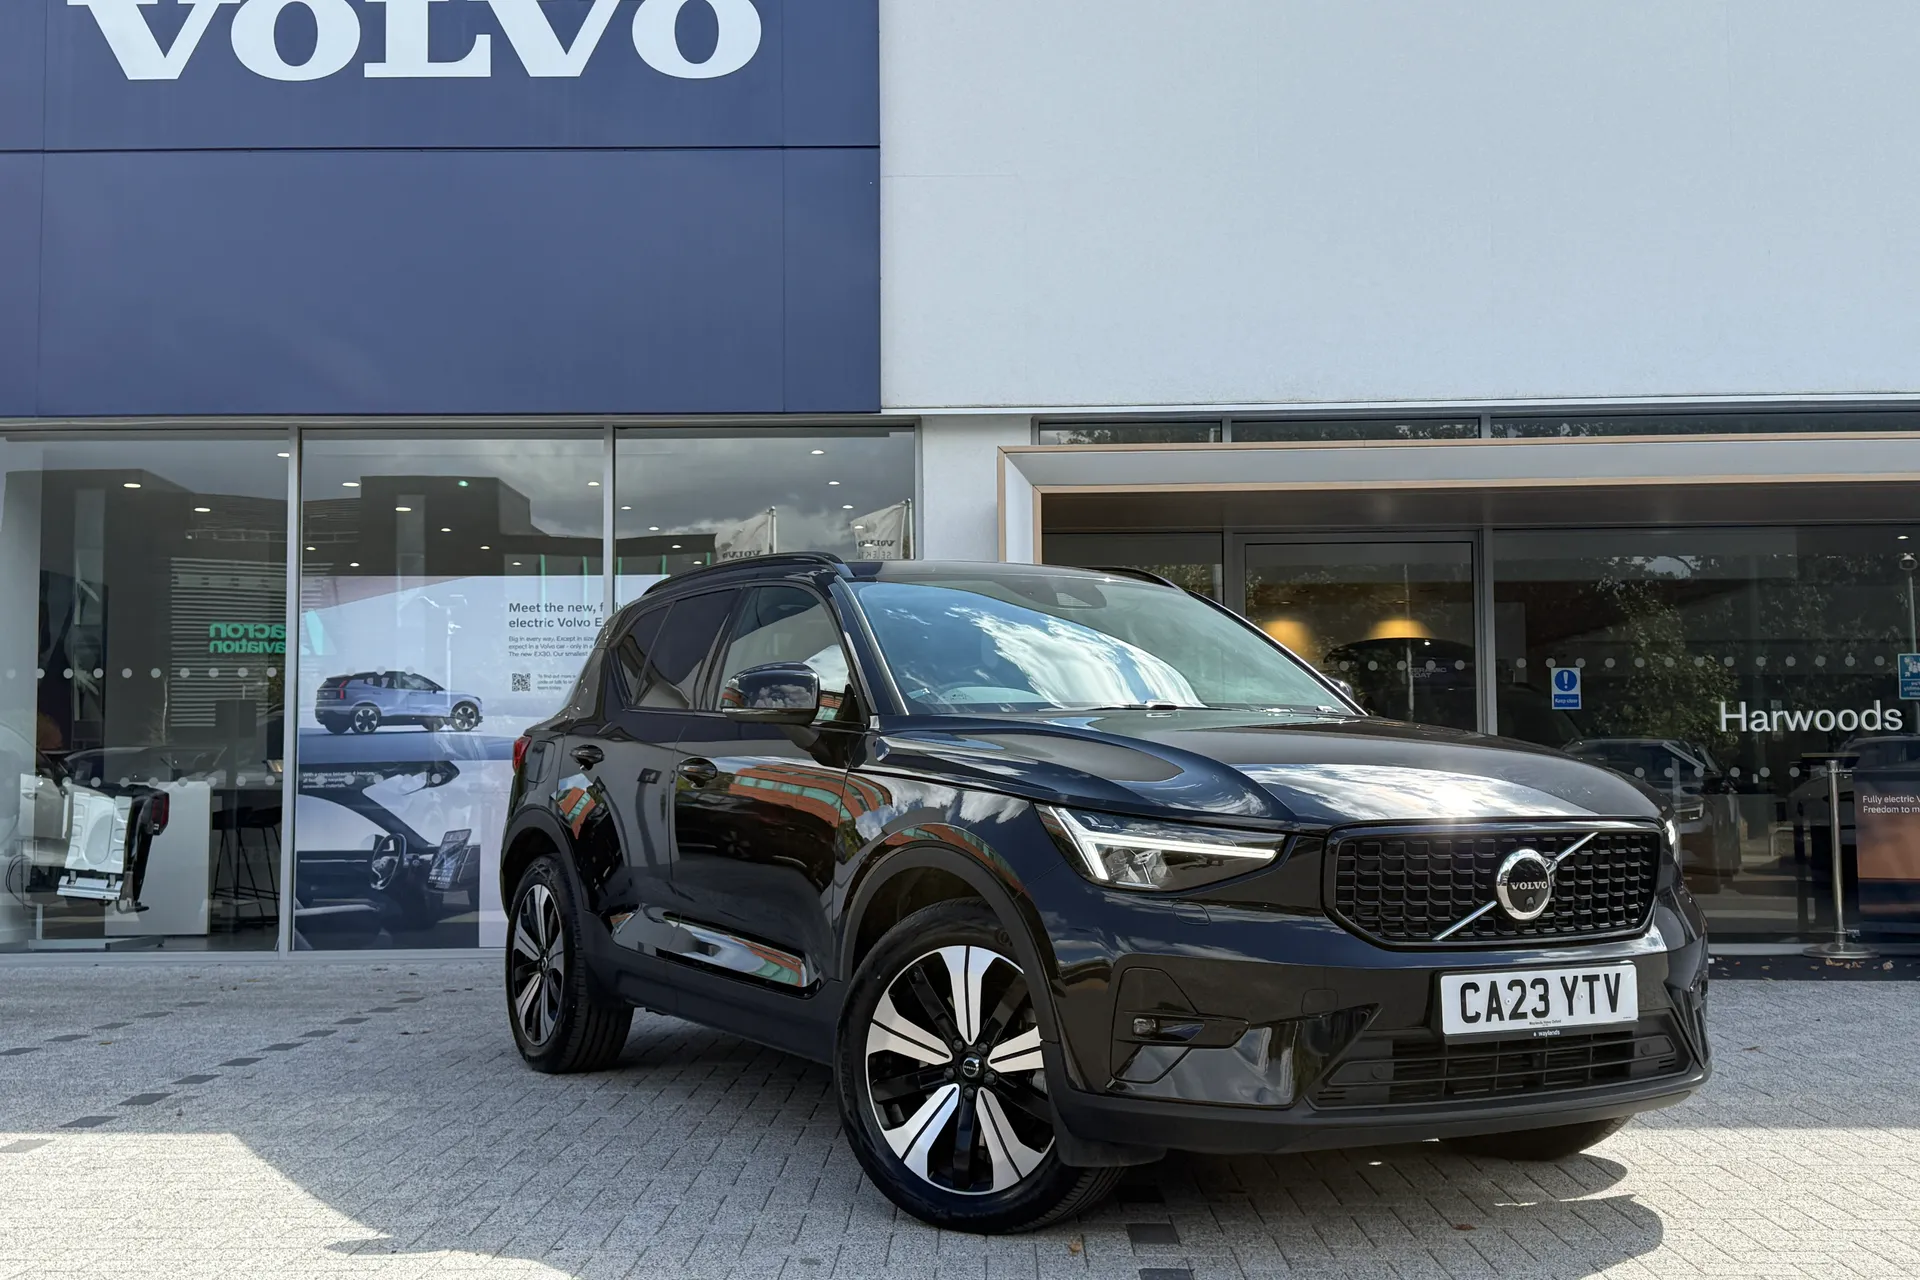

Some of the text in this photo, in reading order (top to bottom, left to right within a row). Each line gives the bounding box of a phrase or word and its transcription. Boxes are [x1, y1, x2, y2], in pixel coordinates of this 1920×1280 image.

[66, 0, 763, 81] VOLVO
[508, 602, 541, 613] Meet
[544, 602, 564, 613] the
[567, 604, 597, 615] new,
[508, 617, 555, 628] electric
[557, 617, 591, 628] Volvo
[1720, 700, 1904, 732] Harwoods
[1862, 795, 1882, 804] Fully
[1883, 794, 1915, 803] electric
[1863, 805, 1900, 813] Freedom
[1509, 881, 1548, 890] VOLVO
[1459, 972, 1622, 1024] CA23 YTV
[1537, 1029, 1561, 1037] waylands
